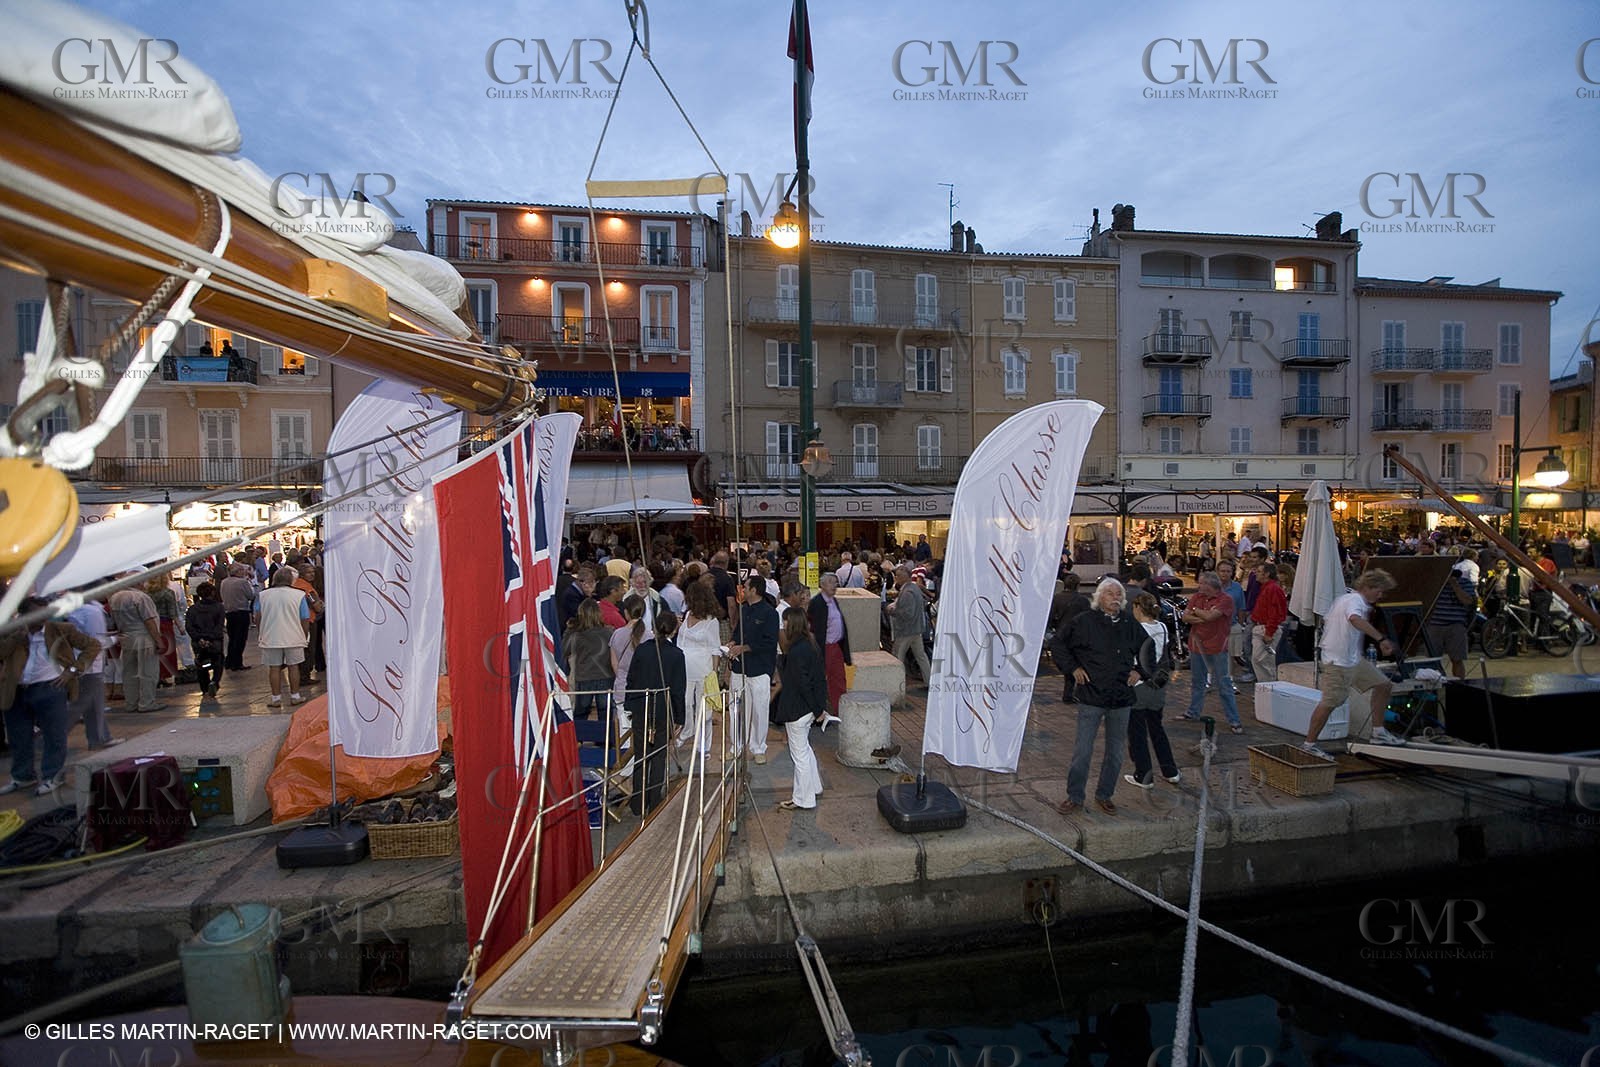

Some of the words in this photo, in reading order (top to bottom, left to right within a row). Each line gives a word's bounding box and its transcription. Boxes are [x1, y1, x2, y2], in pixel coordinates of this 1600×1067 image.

[784, 501, 835, 512] CFE
[844, 501, 873, 512] DE
[883, 501, 938, 511] PARIS
[992, 411, 1062, 532] Classe
[356, 511, 417, 645] Belle
[968, 544, 1026, 669] Belle
[353, 659, 404, 741] La
[955, 676, 1001, 754] La
